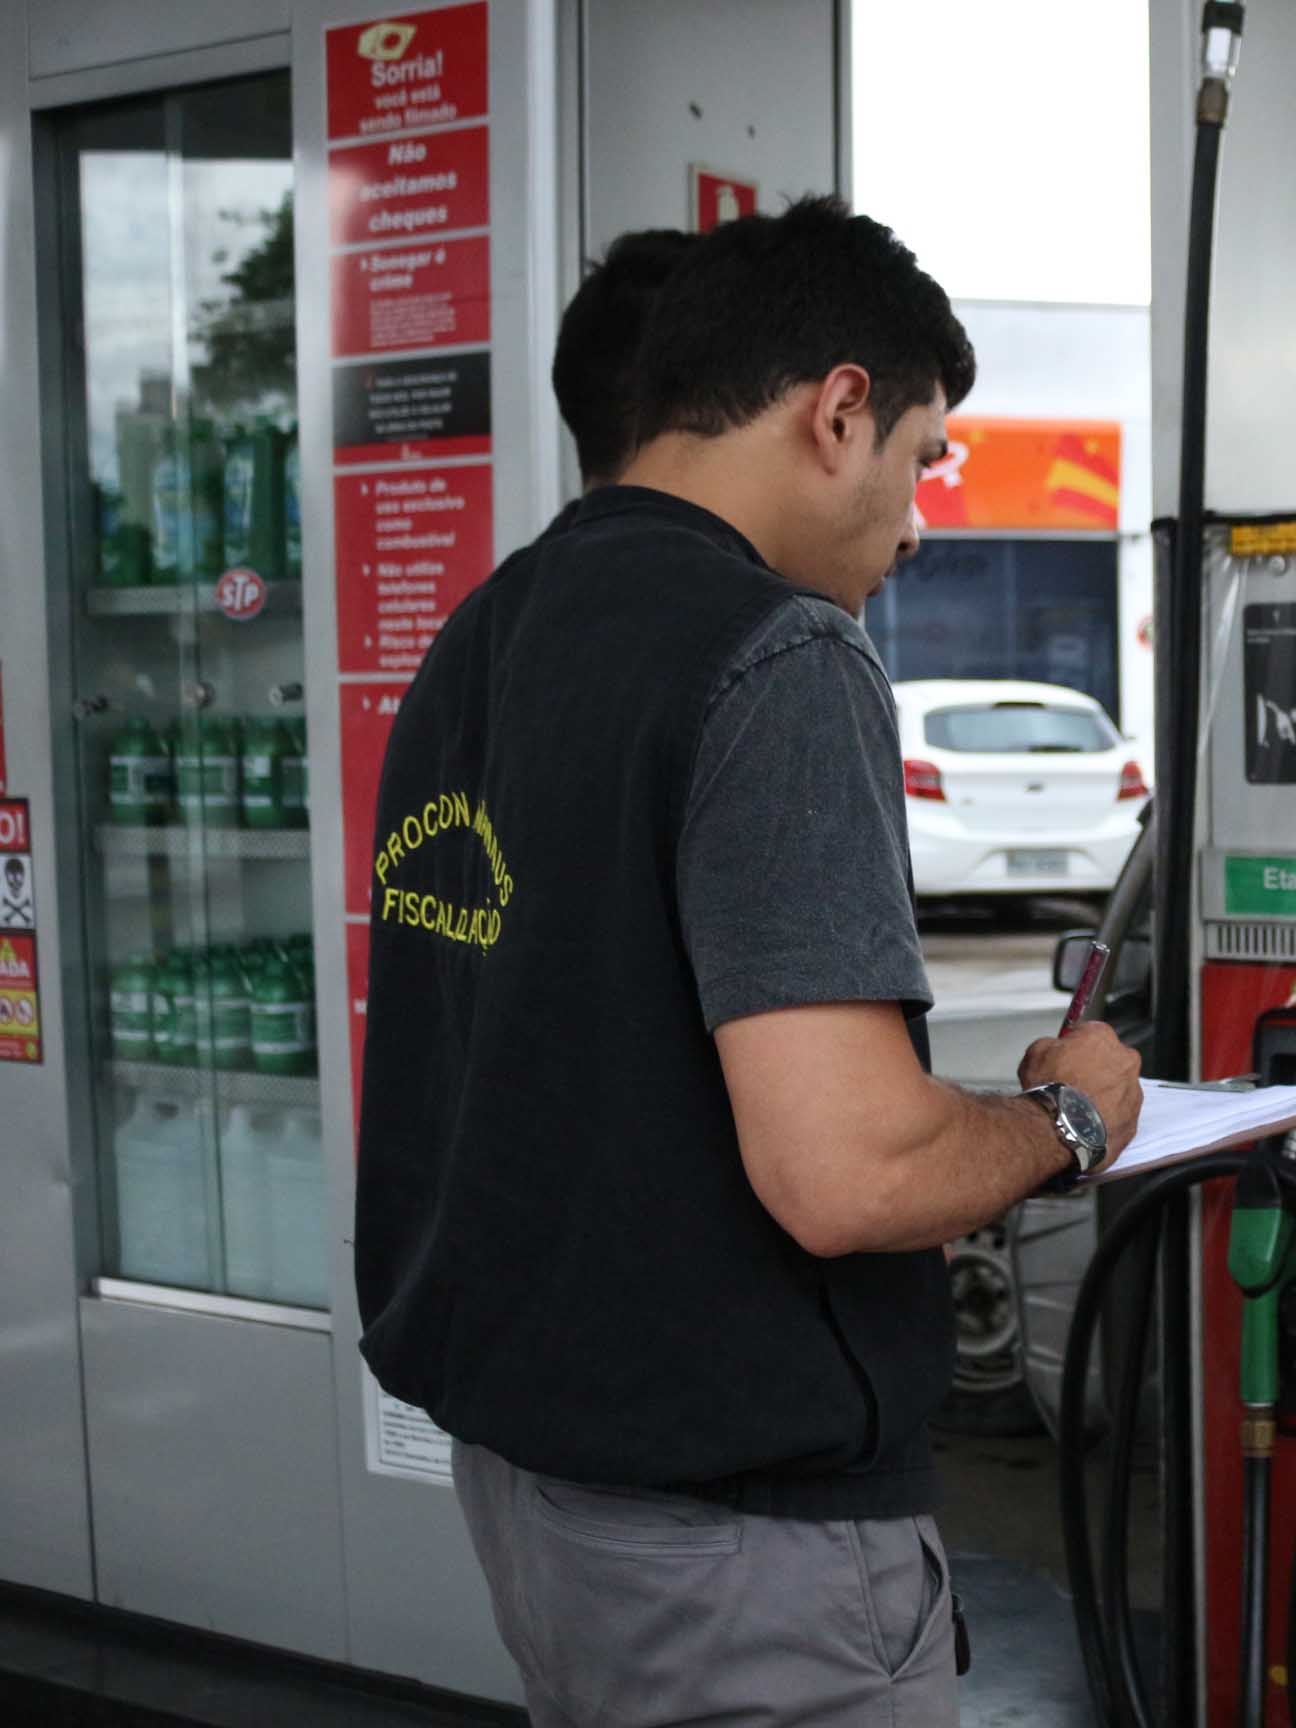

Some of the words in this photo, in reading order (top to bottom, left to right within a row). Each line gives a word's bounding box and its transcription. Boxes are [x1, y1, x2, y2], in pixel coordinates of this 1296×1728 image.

[371, 50, 443, 87] Sorria!
[368, 206, 447, 232] cheques
[223, 574, 259, 611] STP
[375, 791, 470, 886] PROCON
